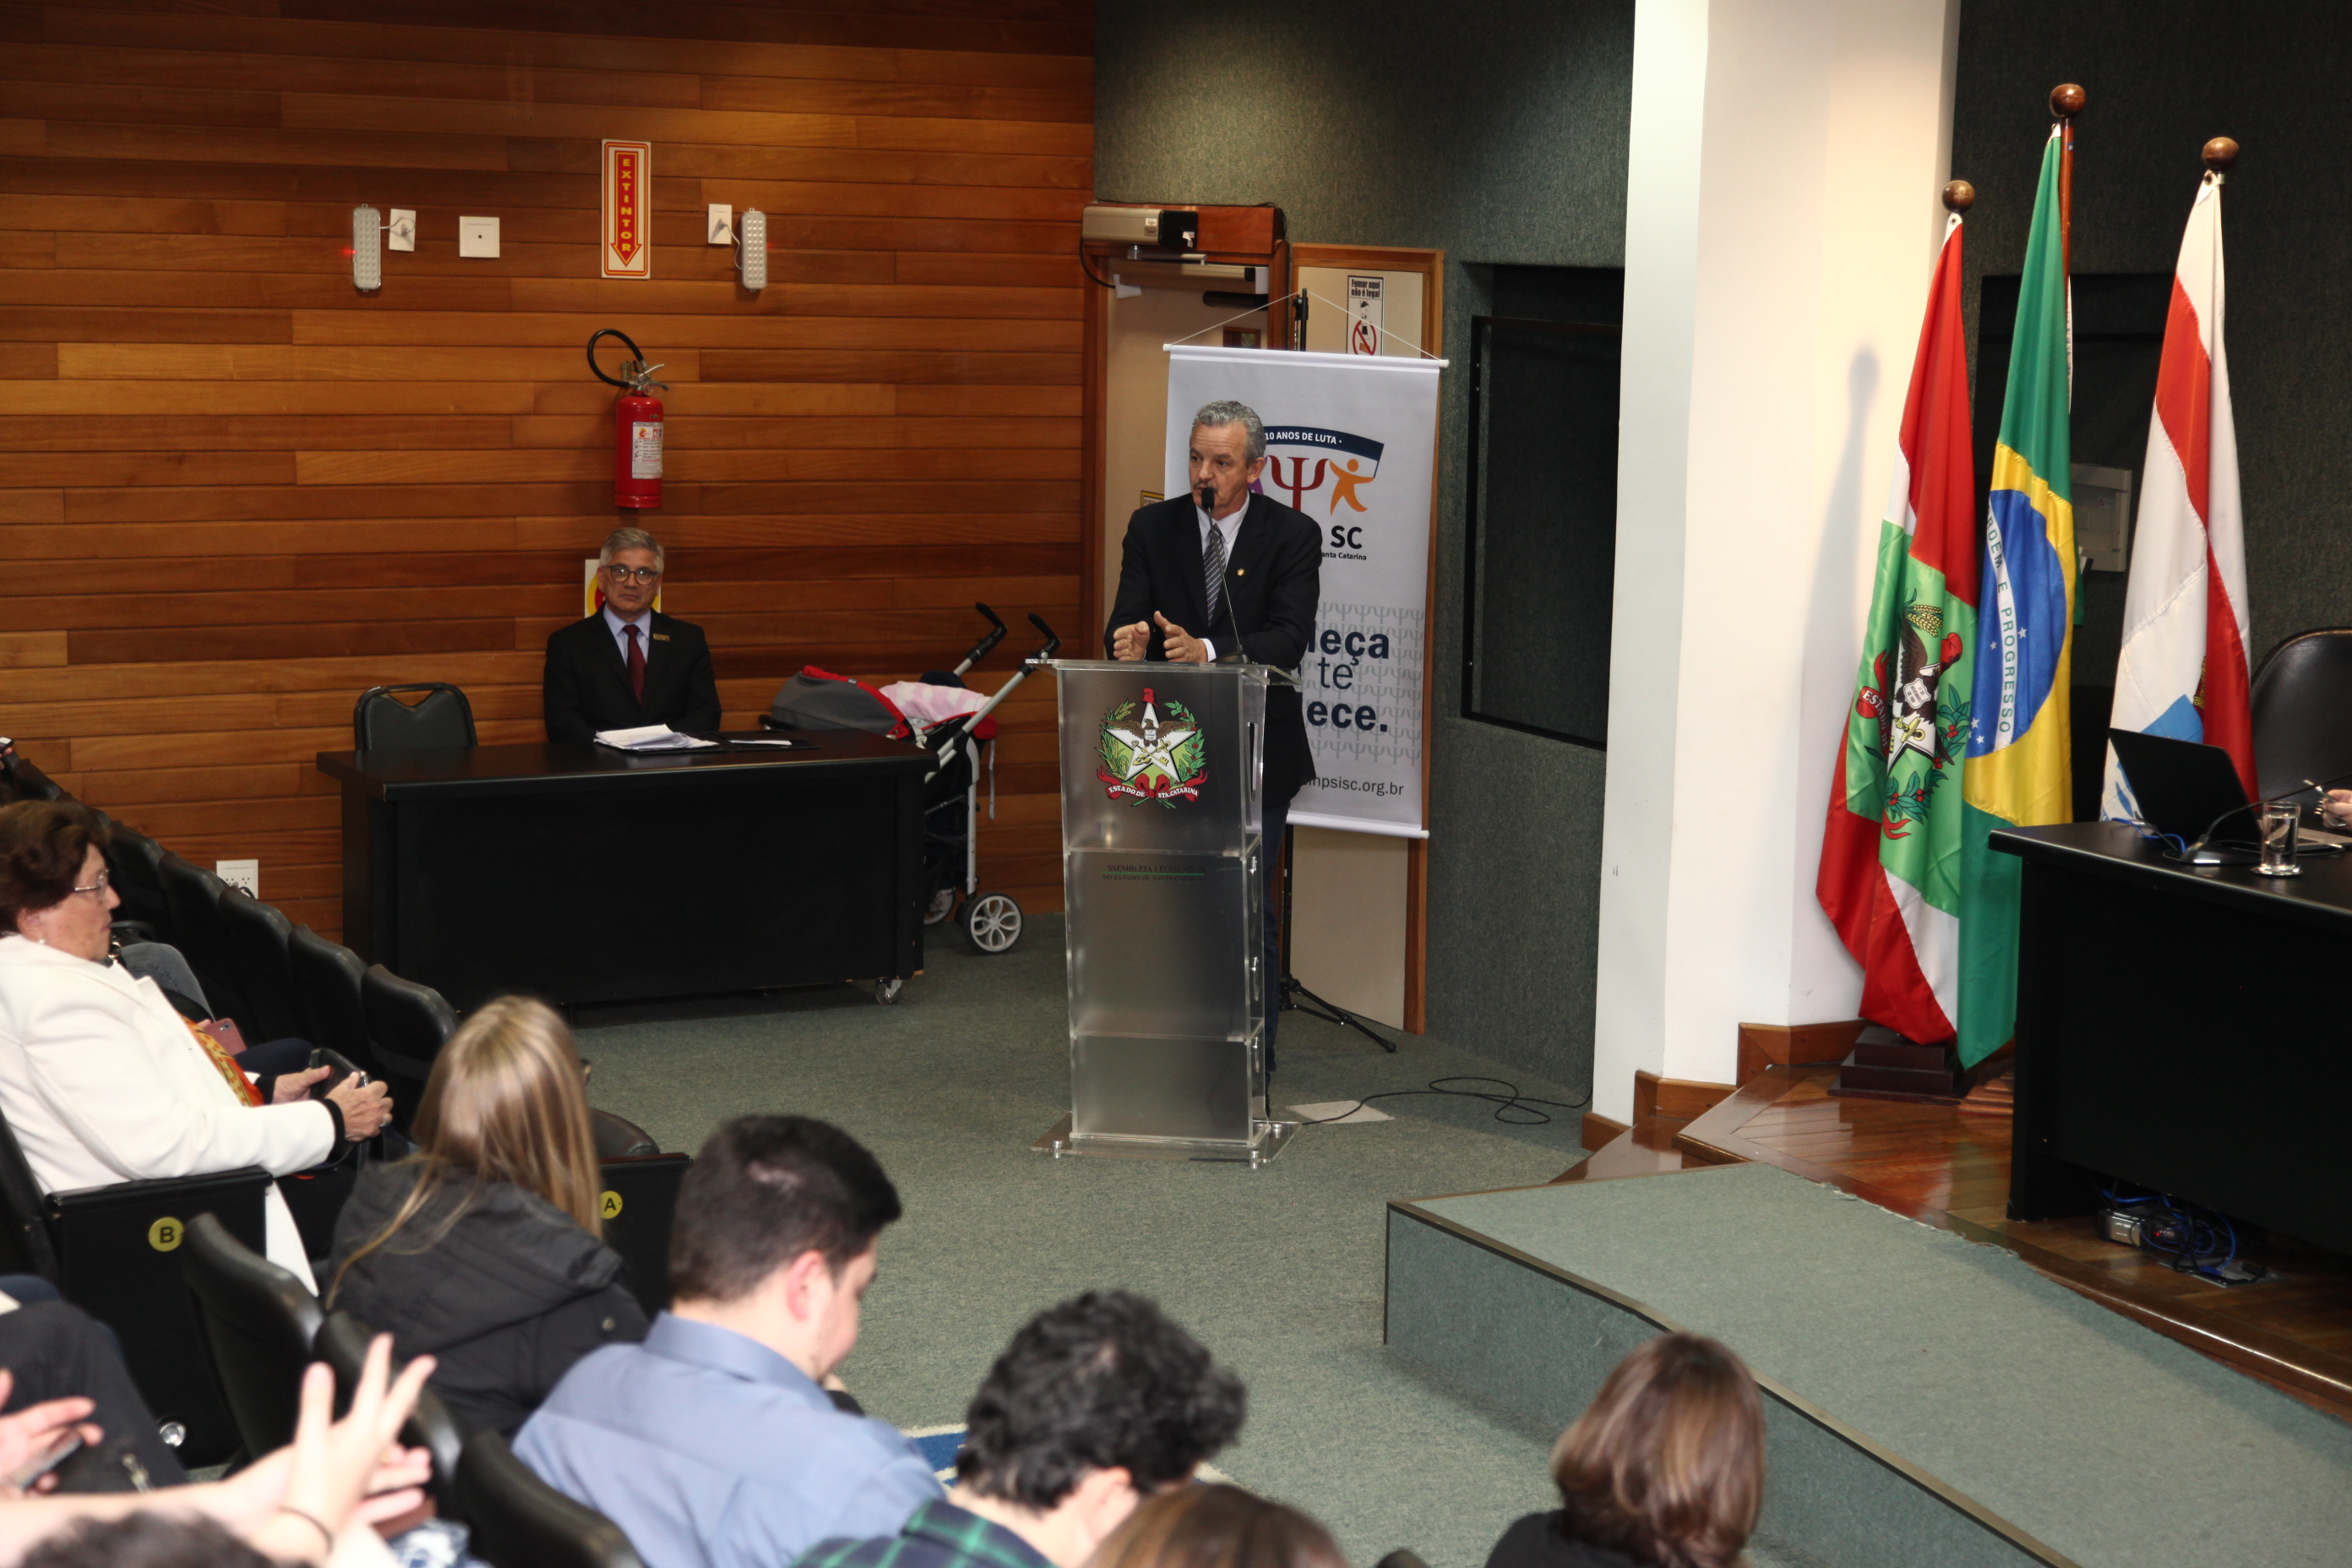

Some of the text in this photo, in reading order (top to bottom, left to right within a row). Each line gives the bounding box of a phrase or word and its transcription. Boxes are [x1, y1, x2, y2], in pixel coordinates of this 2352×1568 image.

[621, 159, 632, 252] EXTINTOR
[1351, 288, 1361, 297] não
[1367, 289, 1380, 298] legal
[1352, 279, 1380, 290] Fumar aqui
[1277, 432, 1299, 440] ANOS
[1302, 433, 1313, 441] DE
[1315, 434, 1337, 444] LUTA
[1330, 525, 1363, 549] SC
[1987, 514, 2015, 732] RDEM E PROGRESSO
[1308, 621, 1390, 666] leça
[1317, 657, 1353, 689] te
[1297, 692, 1388, 732] ece.
[1863, 690, 1886, 730] ESTADO
[1108, 786, 1135, 795] ESTADO
[603, 1197, 617, 1212] A
[160, 1226, 175, 1244] B
